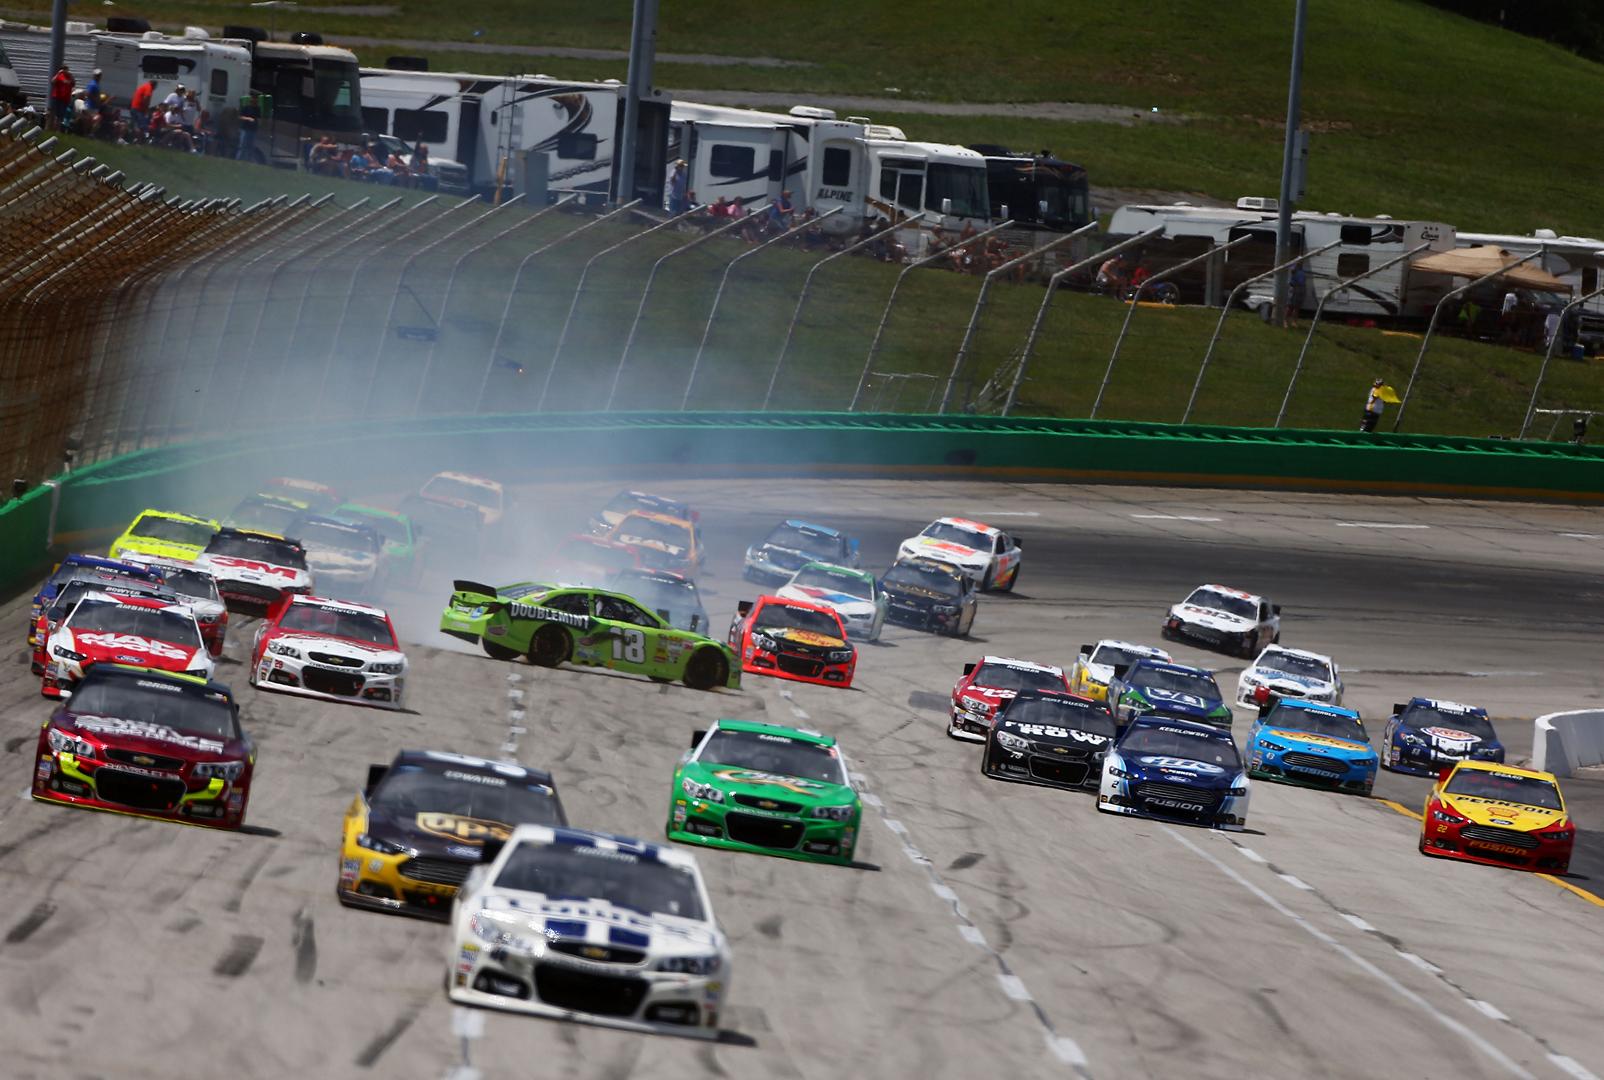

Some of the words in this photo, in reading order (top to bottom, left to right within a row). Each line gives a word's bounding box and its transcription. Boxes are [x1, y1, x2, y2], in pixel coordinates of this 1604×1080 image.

[209, 557, 297, 581] 3M
[105, 586, 141, 596] BOWYER
[115, 603, 162, 615] AMBROSE
[320, 605, 358, 615] HARVICK
[511, 601, 590, 629] DOUBLEMINT
[609, 626, 646, 664] 18
[136, 680, 183, 692] GORDON
[1020, 727, 1105, 746] ROW
[1158, 726, 1209, 738] KESELOWSKI
[104, 762, 162, 777] CHEVROLET
[1291, 766, 1340, 779] FUSION
[1111, 780, 1120, 789] 2
[1144, 797, 1204, 812] FUSION
[1455, 796, 1554, 816] PENNZOIL
[1436, 824, 1448, 833] 22
[1467, 840, 1528, 855] FUSION
